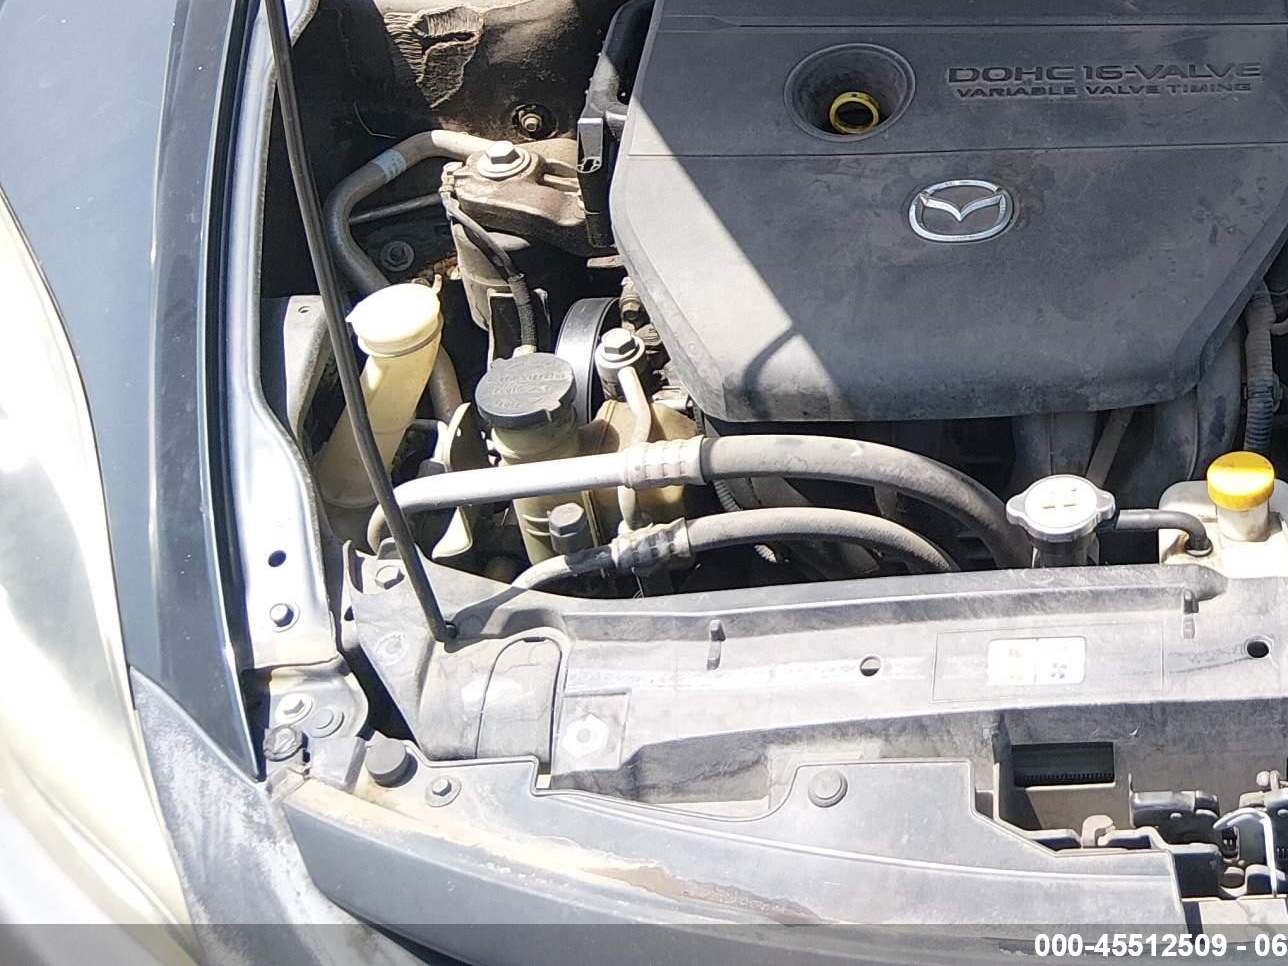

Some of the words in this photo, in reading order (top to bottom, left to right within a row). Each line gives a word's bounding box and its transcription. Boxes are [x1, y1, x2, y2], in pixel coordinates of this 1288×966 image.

[948, 65, 1075, 84] DOHC
[1082, 62, 1261, 81] 16-VALVE
[957, 85, 1077, 98] VARIABLE
[1085, 83, 1161, 96] VALVE
[1166, 82, 1252, 94] TIMING
